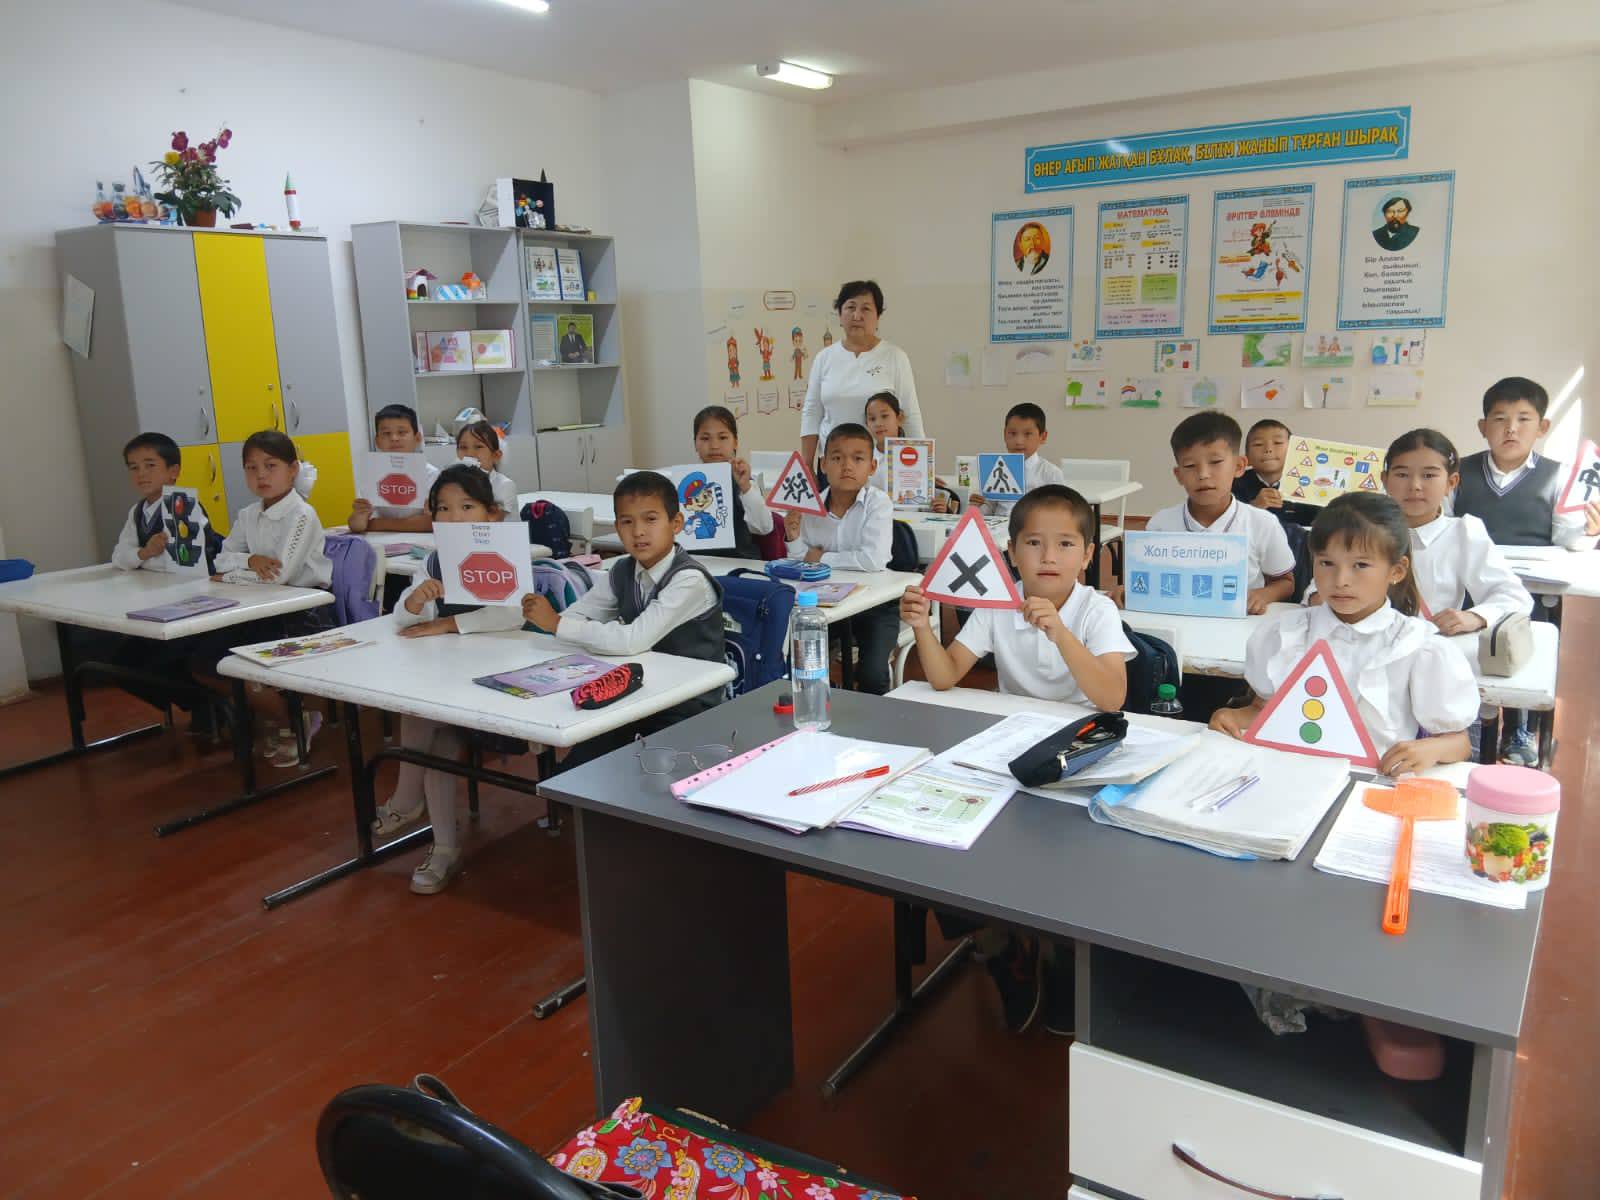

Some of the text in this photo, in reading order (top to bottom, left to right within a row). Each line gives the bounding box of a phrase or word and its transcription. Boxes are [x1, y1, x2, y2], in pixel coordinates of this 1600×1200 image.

[1033, 160, 1061, 177] ӨНЕР
[1064, 156, 1095, 174] АҒЫП
[1099, 151, 1147, 170] ЖАТҚАН
[1195, 141, 1235, 161] БІЛІМ
[1237, 136, 1289, 156] ЖАНЫП
[1291, 131, 1341, 150] ТҰРҒАН
[1344, 126, 1399, 146] ШЫРАҚ
[1117, 208, 1169, 219] МАТЕМАТИКА
[380, 484, 416, 495] STOP
[1143, 545, 1228, 562] Жол белгілері
[463, 569, 514, 585] STOP
